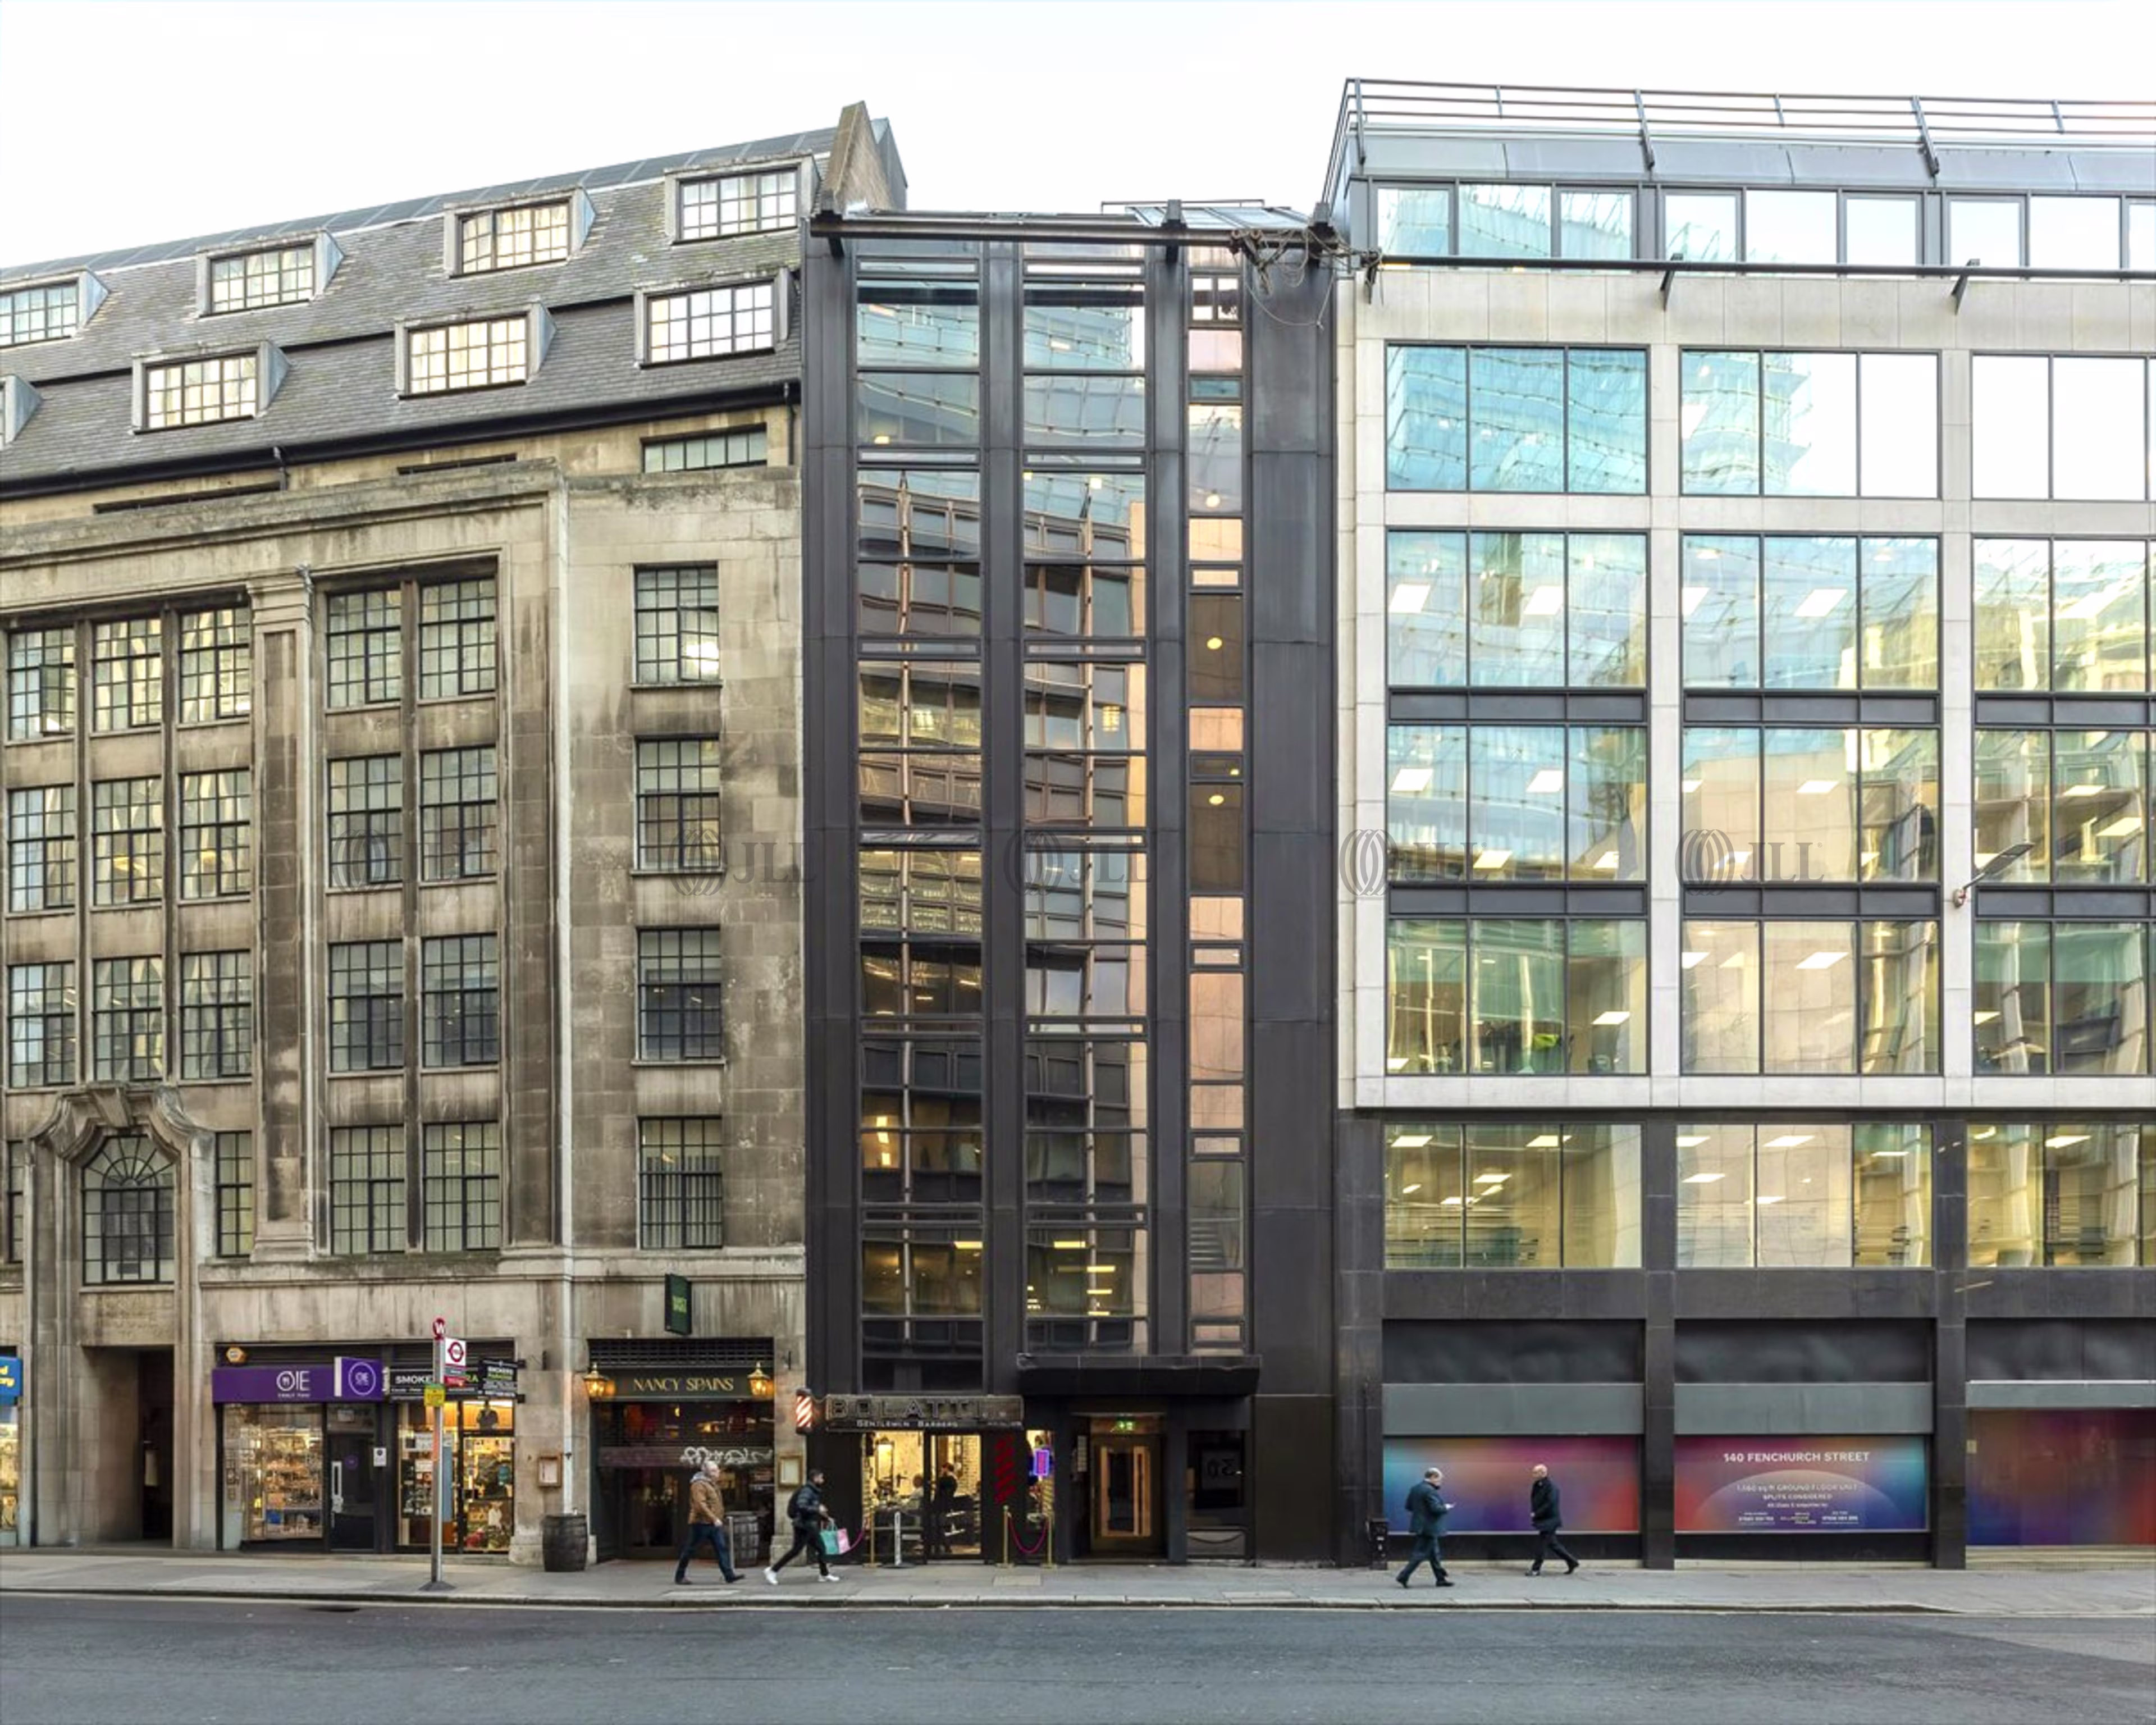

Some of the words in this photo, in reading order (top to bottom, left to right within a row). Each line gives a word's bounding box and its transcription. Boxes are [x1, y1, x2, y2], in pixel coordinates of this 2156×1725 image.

[395, 1375, 433, 1384] SMOKE
[633, 1378, 681, 1391] NANCY
[686, 1378, 734, 1391] SPAINS
[1747, 1453, 1821, 1462] FENCHURCH
[1824, 1451, 1870, 1461] STREET
